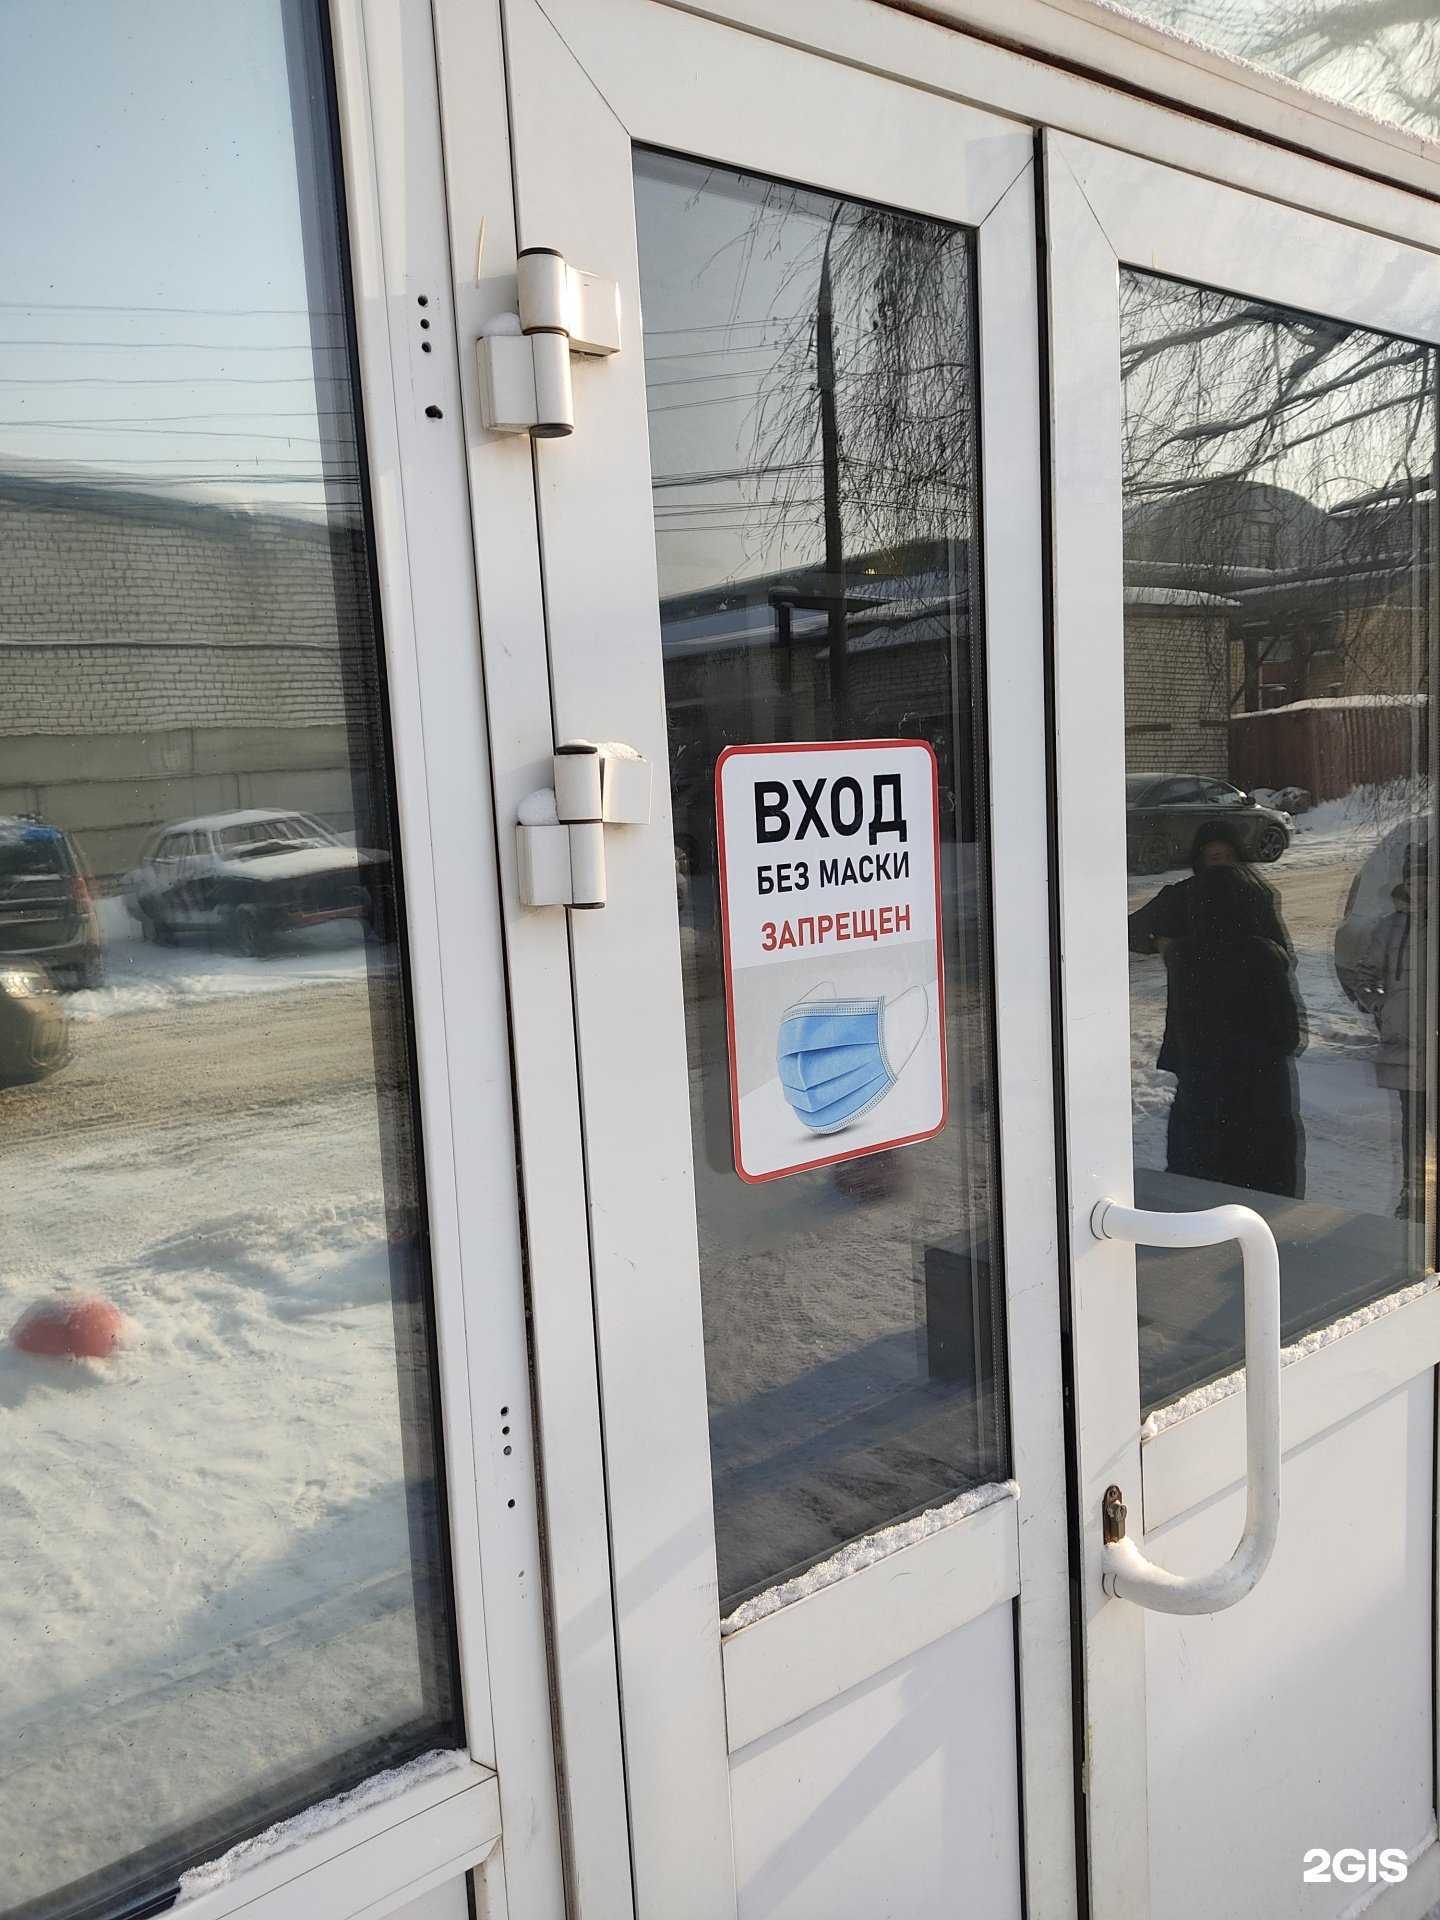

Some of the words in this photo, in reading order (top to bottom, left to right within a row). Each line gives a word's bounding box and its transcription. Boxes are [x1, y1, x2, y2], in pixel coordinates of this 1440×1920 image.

[754, 773, 907, 845] ВХОД
[757, 861, 810, 895] БЕЗ
[819, 851, 910, 888] МАСКИ
[761, 904, 911, 951] ЗАПРЕЩЕН
